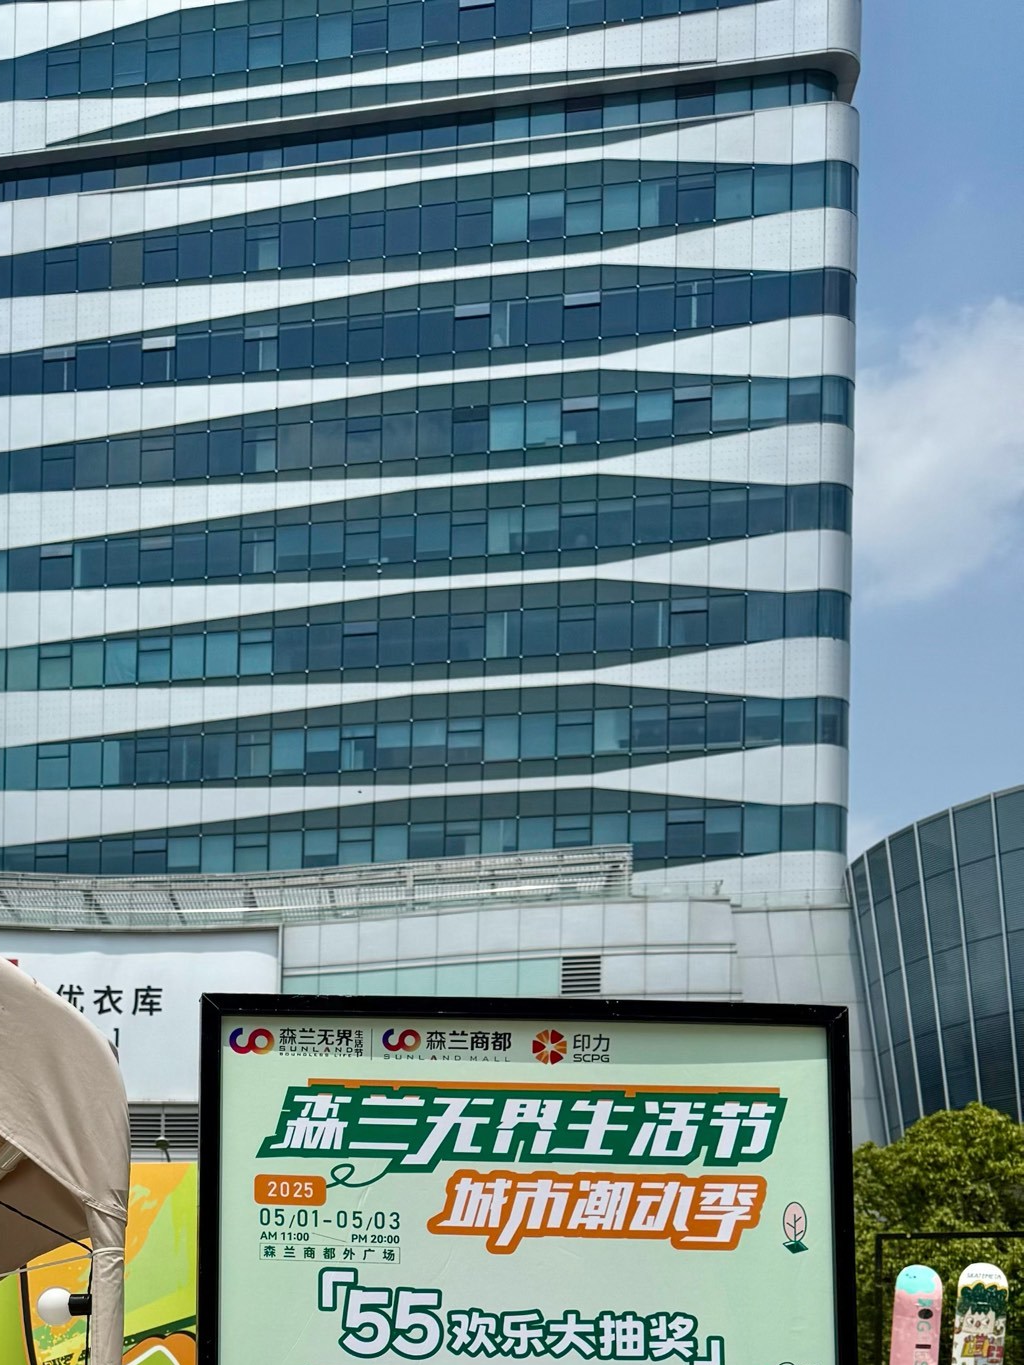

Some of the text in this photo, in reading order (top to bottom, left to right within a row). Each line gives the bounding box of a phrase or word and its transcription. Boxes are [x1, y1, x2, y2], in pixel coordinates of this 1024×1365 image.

[56, 984, 163, 1016] 优衣库
[279, 1028, 354, 1046] 森兰无界
[354, 1030, 364, 1057] 生活节
[426, 1030, 512, 1051] 森兰商都
[573, 1034, 610, 1052] 印力
[573, 1054, 610, 1063] SCPG
[271, 1093, 777, 1165] 森兰无界生活节
[267, 1181, 314, 1198] 2025
[259, 1207, 401, 1231] 05/01-05/03
[437, 1178, 758, 1244] 城市潮动季
[260, 1231, 400, 1244] AM 11:00 PM 20:00
[263, 1245, 395, 1261] 森兰商都外广场
